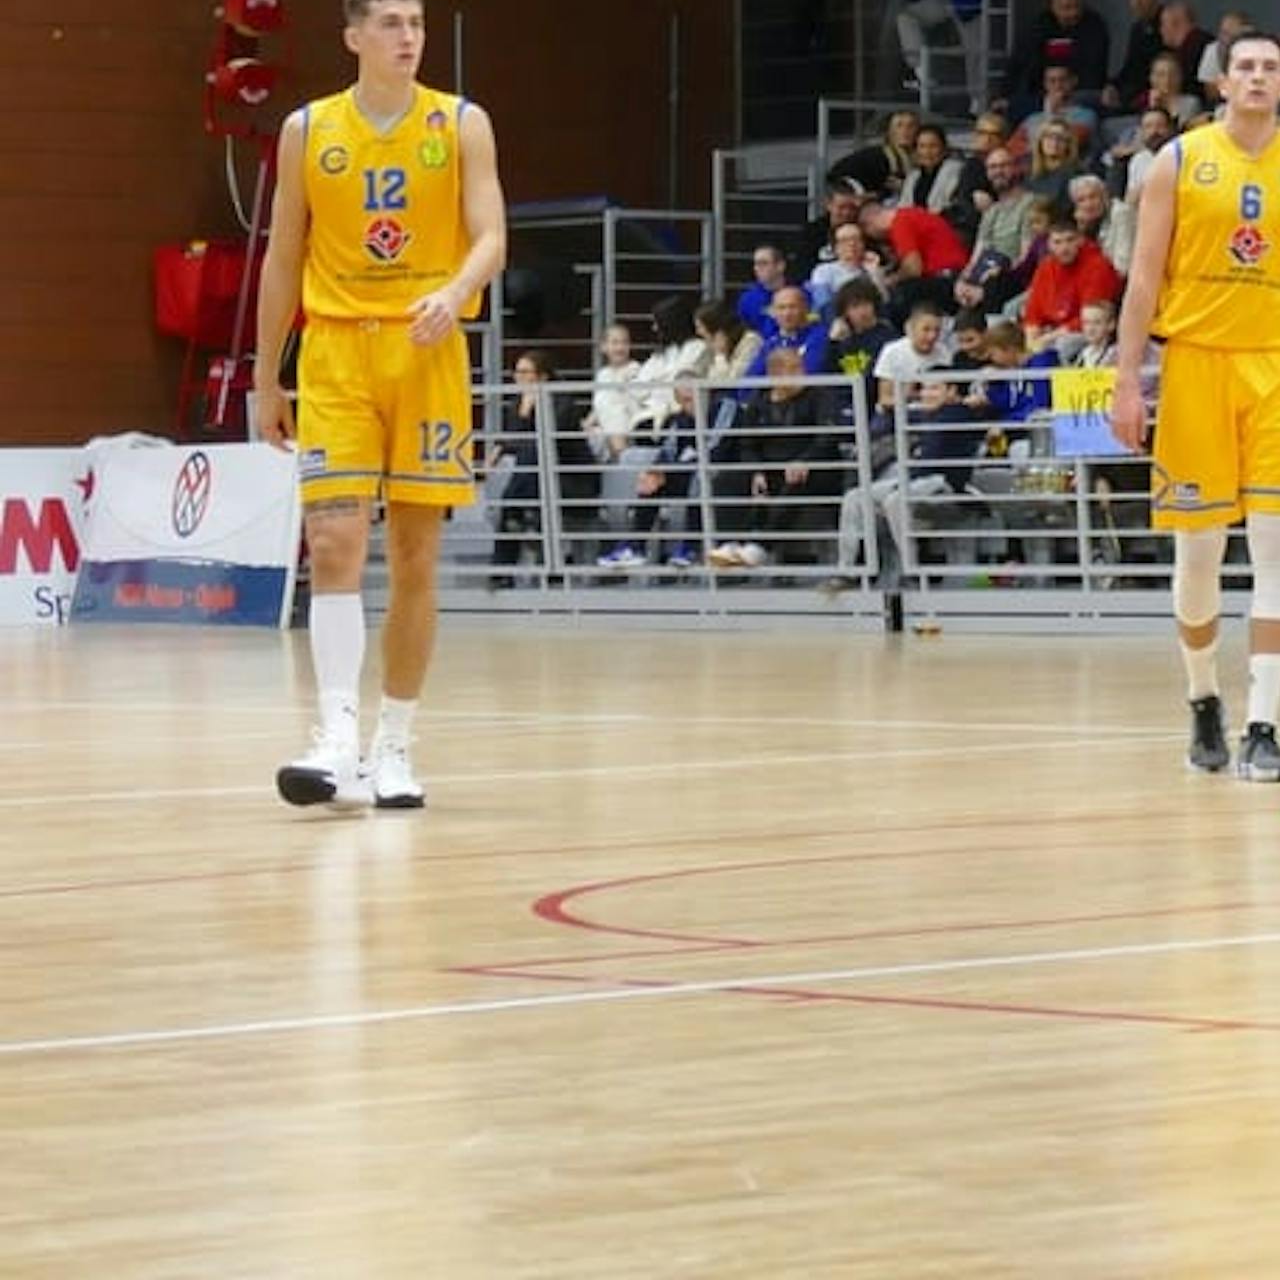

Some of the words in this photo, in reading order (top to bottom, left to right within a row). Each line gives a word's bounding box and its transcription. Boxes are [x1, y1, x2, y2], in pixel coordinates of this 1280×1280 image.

[363, 168, 407, 210] 12
[1241, 185, 1262, 220] 6
[420, 421, 451, 461] 12
